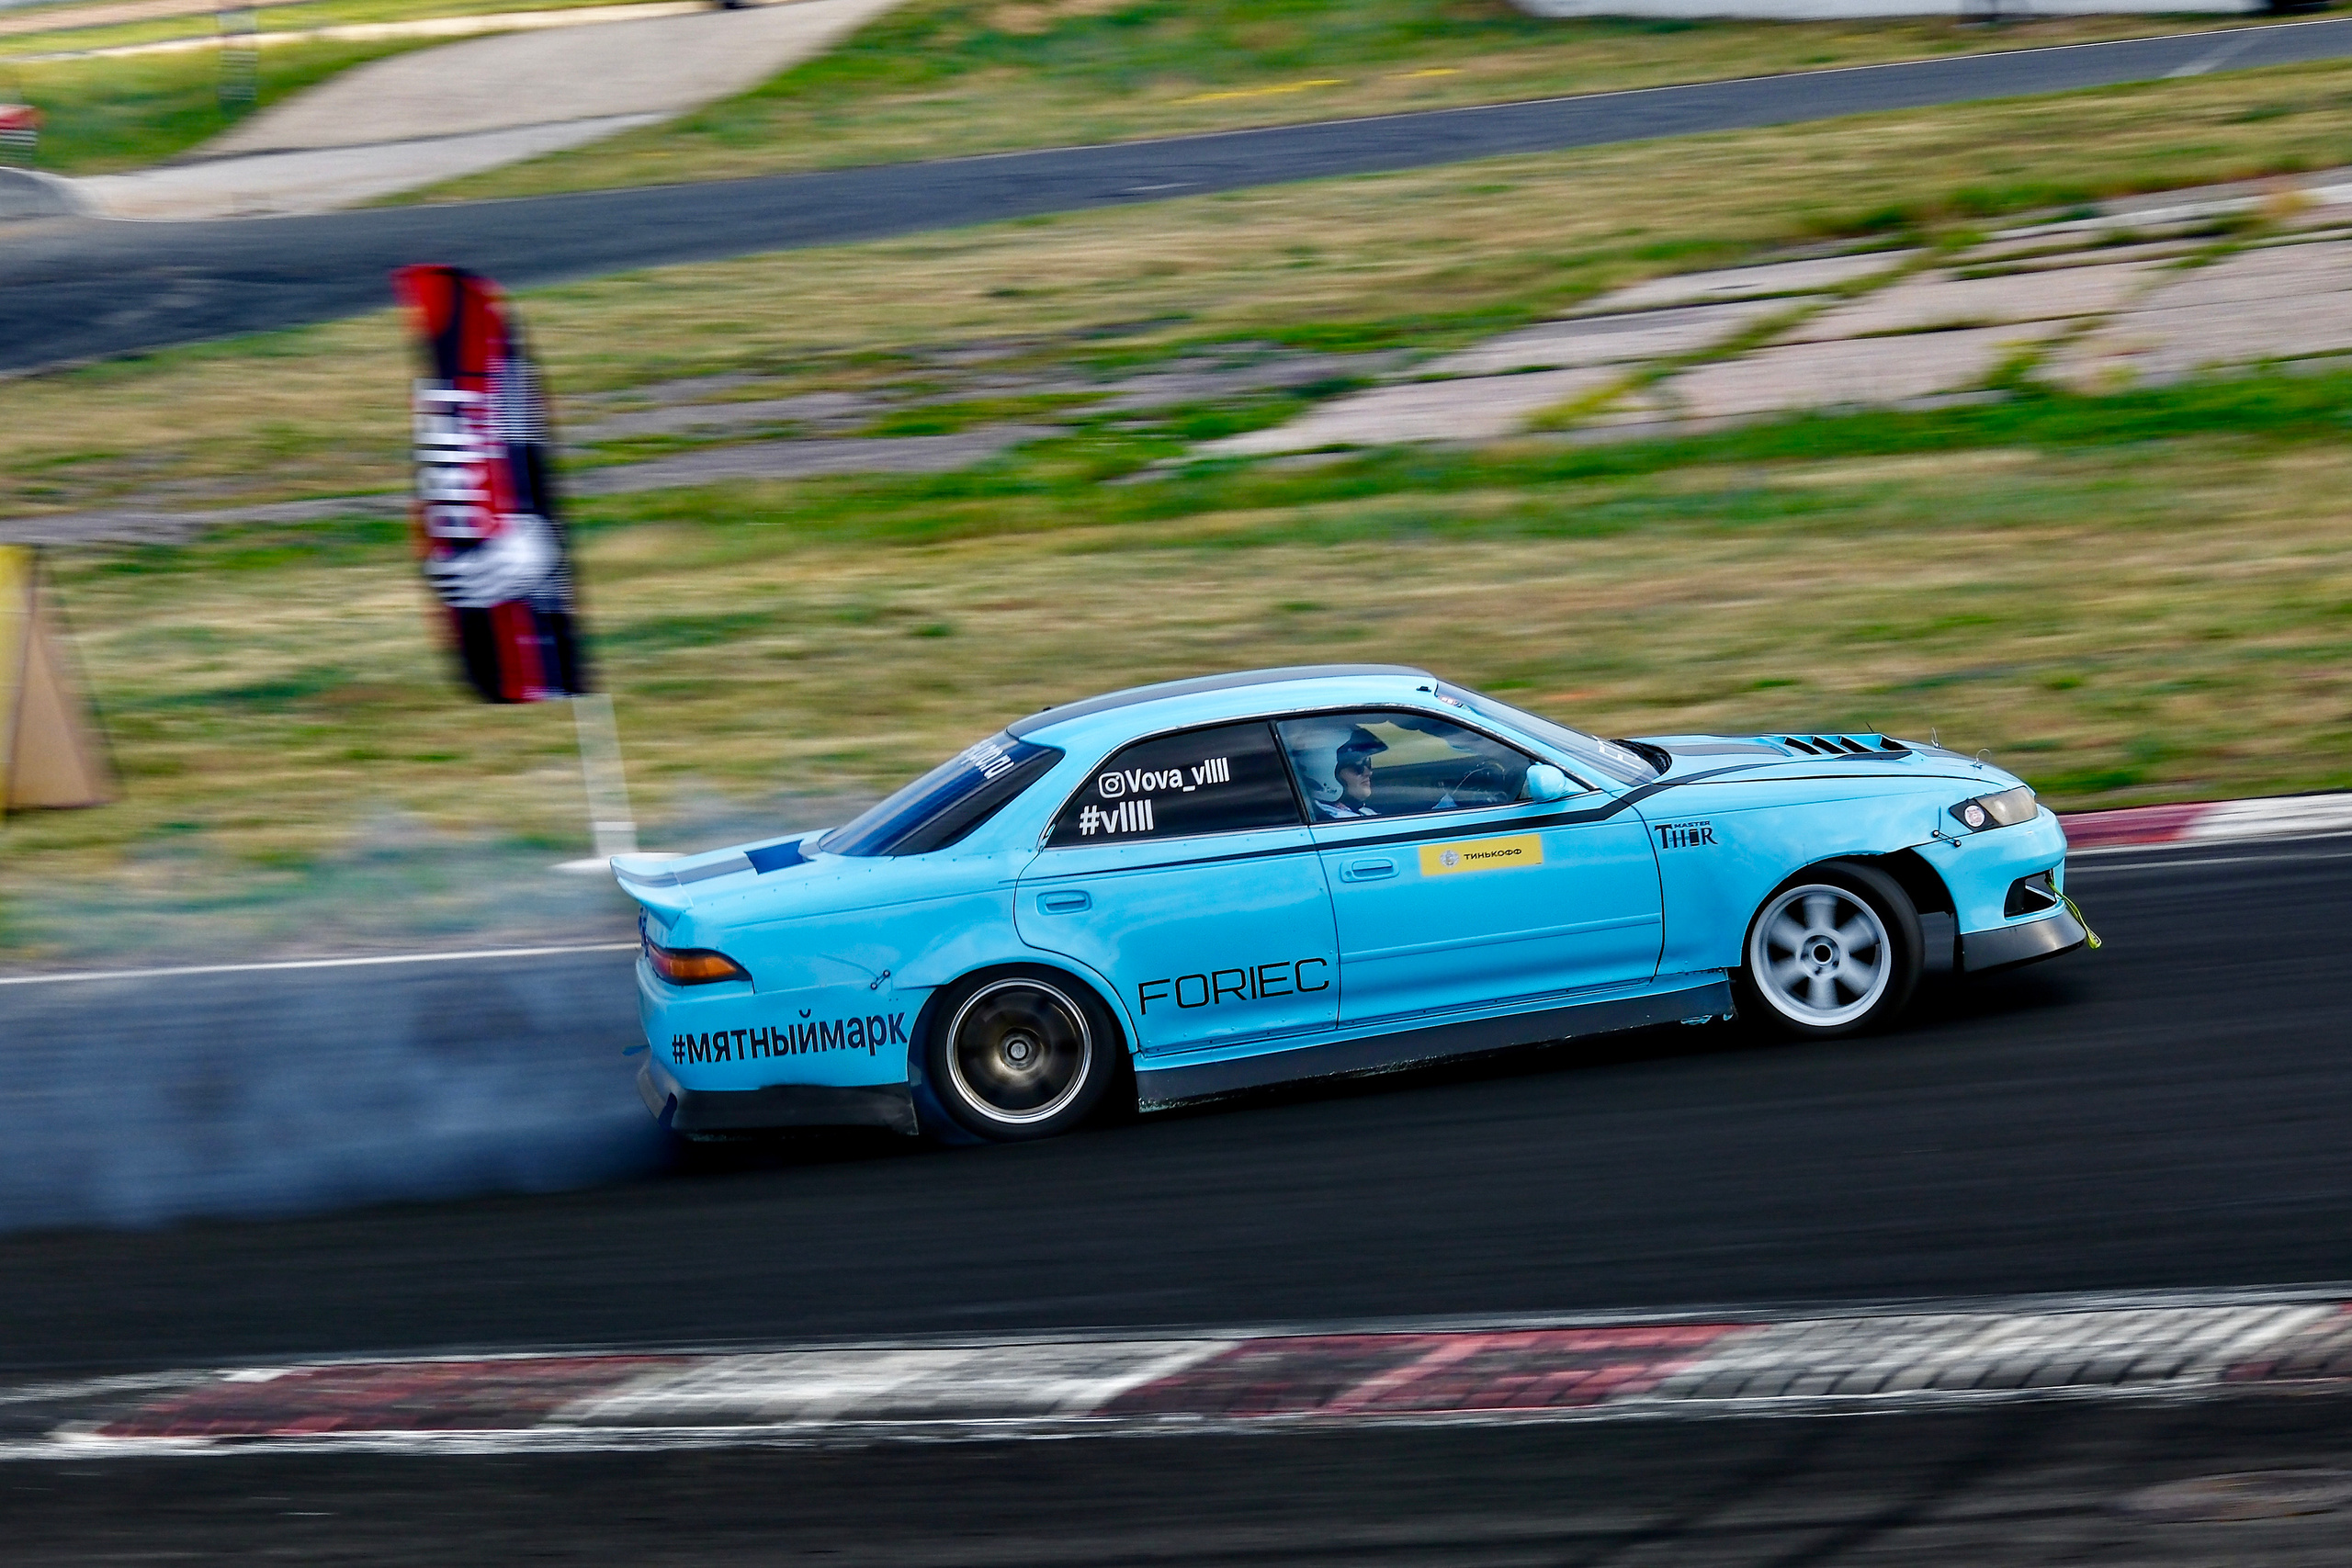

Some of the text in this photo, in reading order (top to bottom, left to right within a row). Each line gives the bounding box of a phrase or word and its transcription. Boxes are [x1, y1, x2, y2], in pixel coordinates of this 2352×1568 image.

[1464, 848, 1522, 860] ТИНЬКОФФ
[1137, 957, 1330, 1016] FORIEC
[672, 1009, 908, 1066] #мятныймарк
